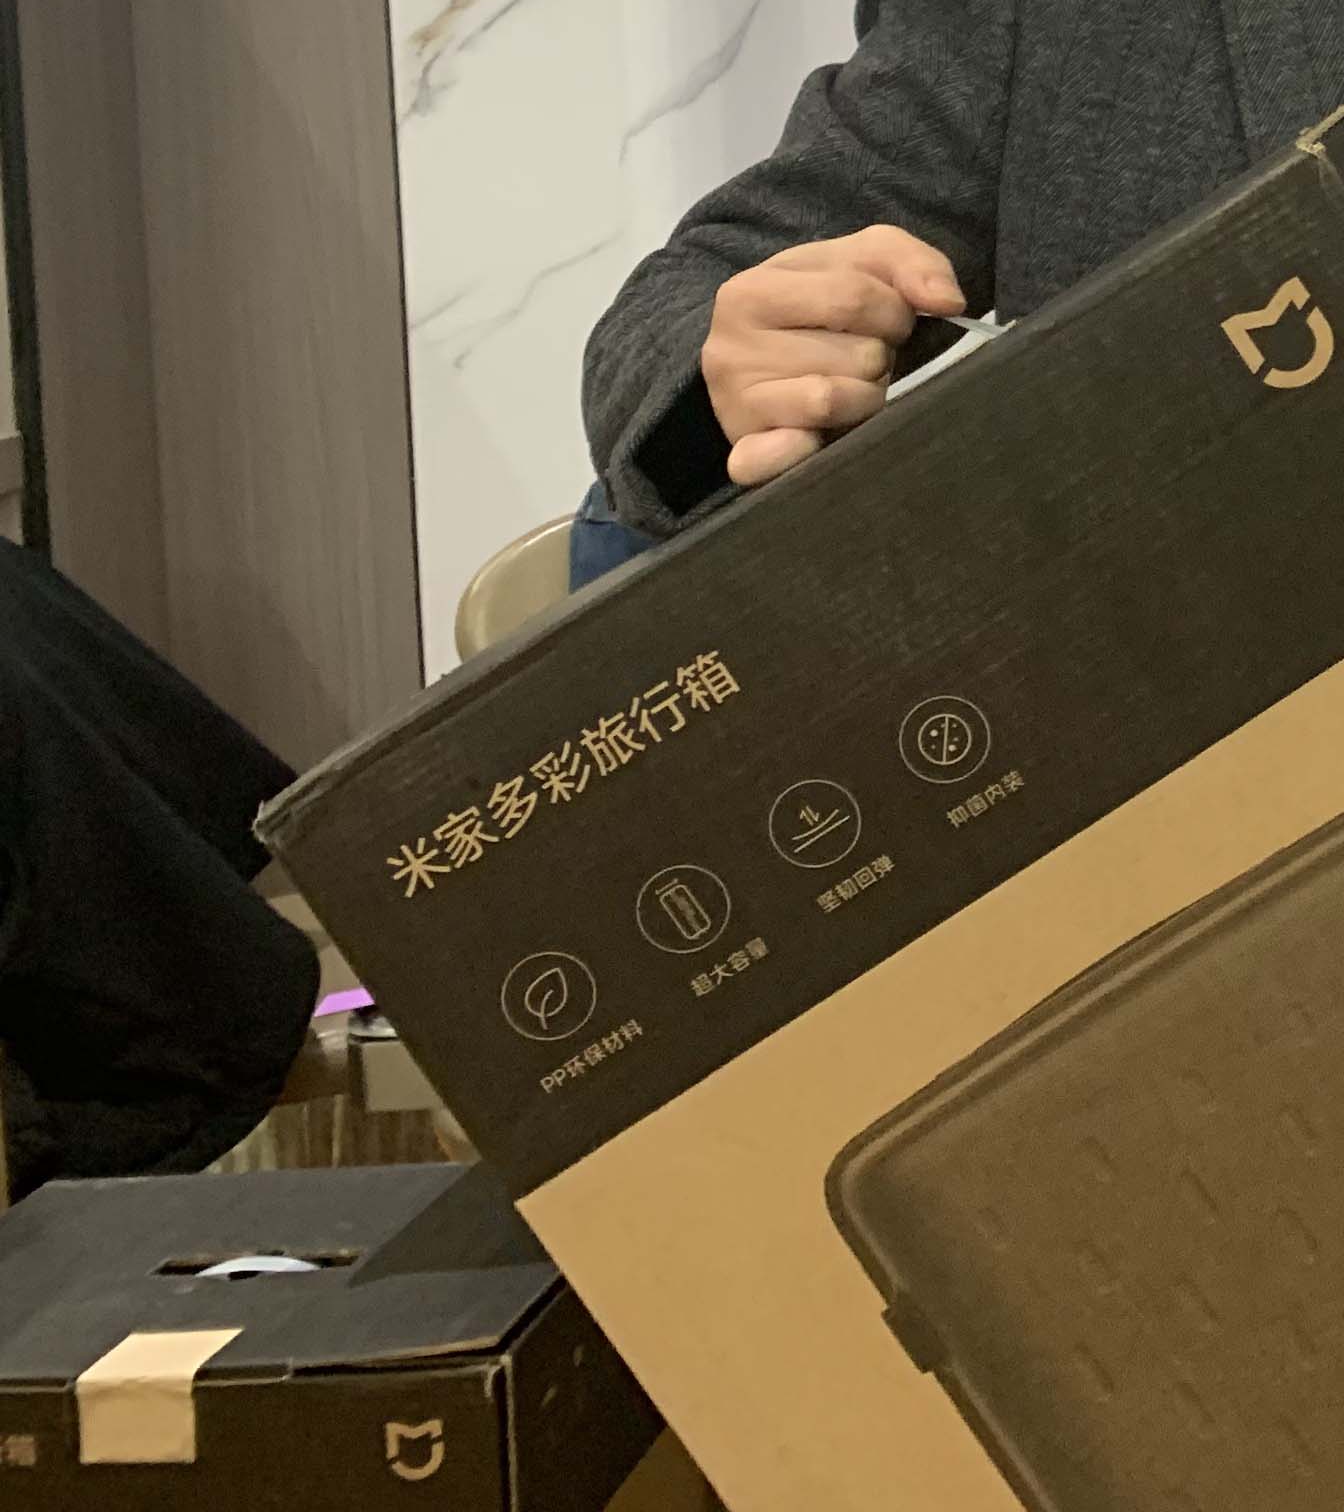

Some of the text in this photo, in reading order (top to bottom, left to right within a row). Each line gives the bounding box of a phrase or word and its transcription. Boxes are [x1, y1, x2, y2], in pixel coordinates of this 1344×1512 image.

[386, 650, 741, 899] 米家多彩旅行箱
[945, 771, 1025, 828] 抑菌内装
[816, 854, 895, 914] 坚韧回弹
[690, 937, 770, 998] 超大容量
[540, 1018, 644, 1095] PP环保材料
